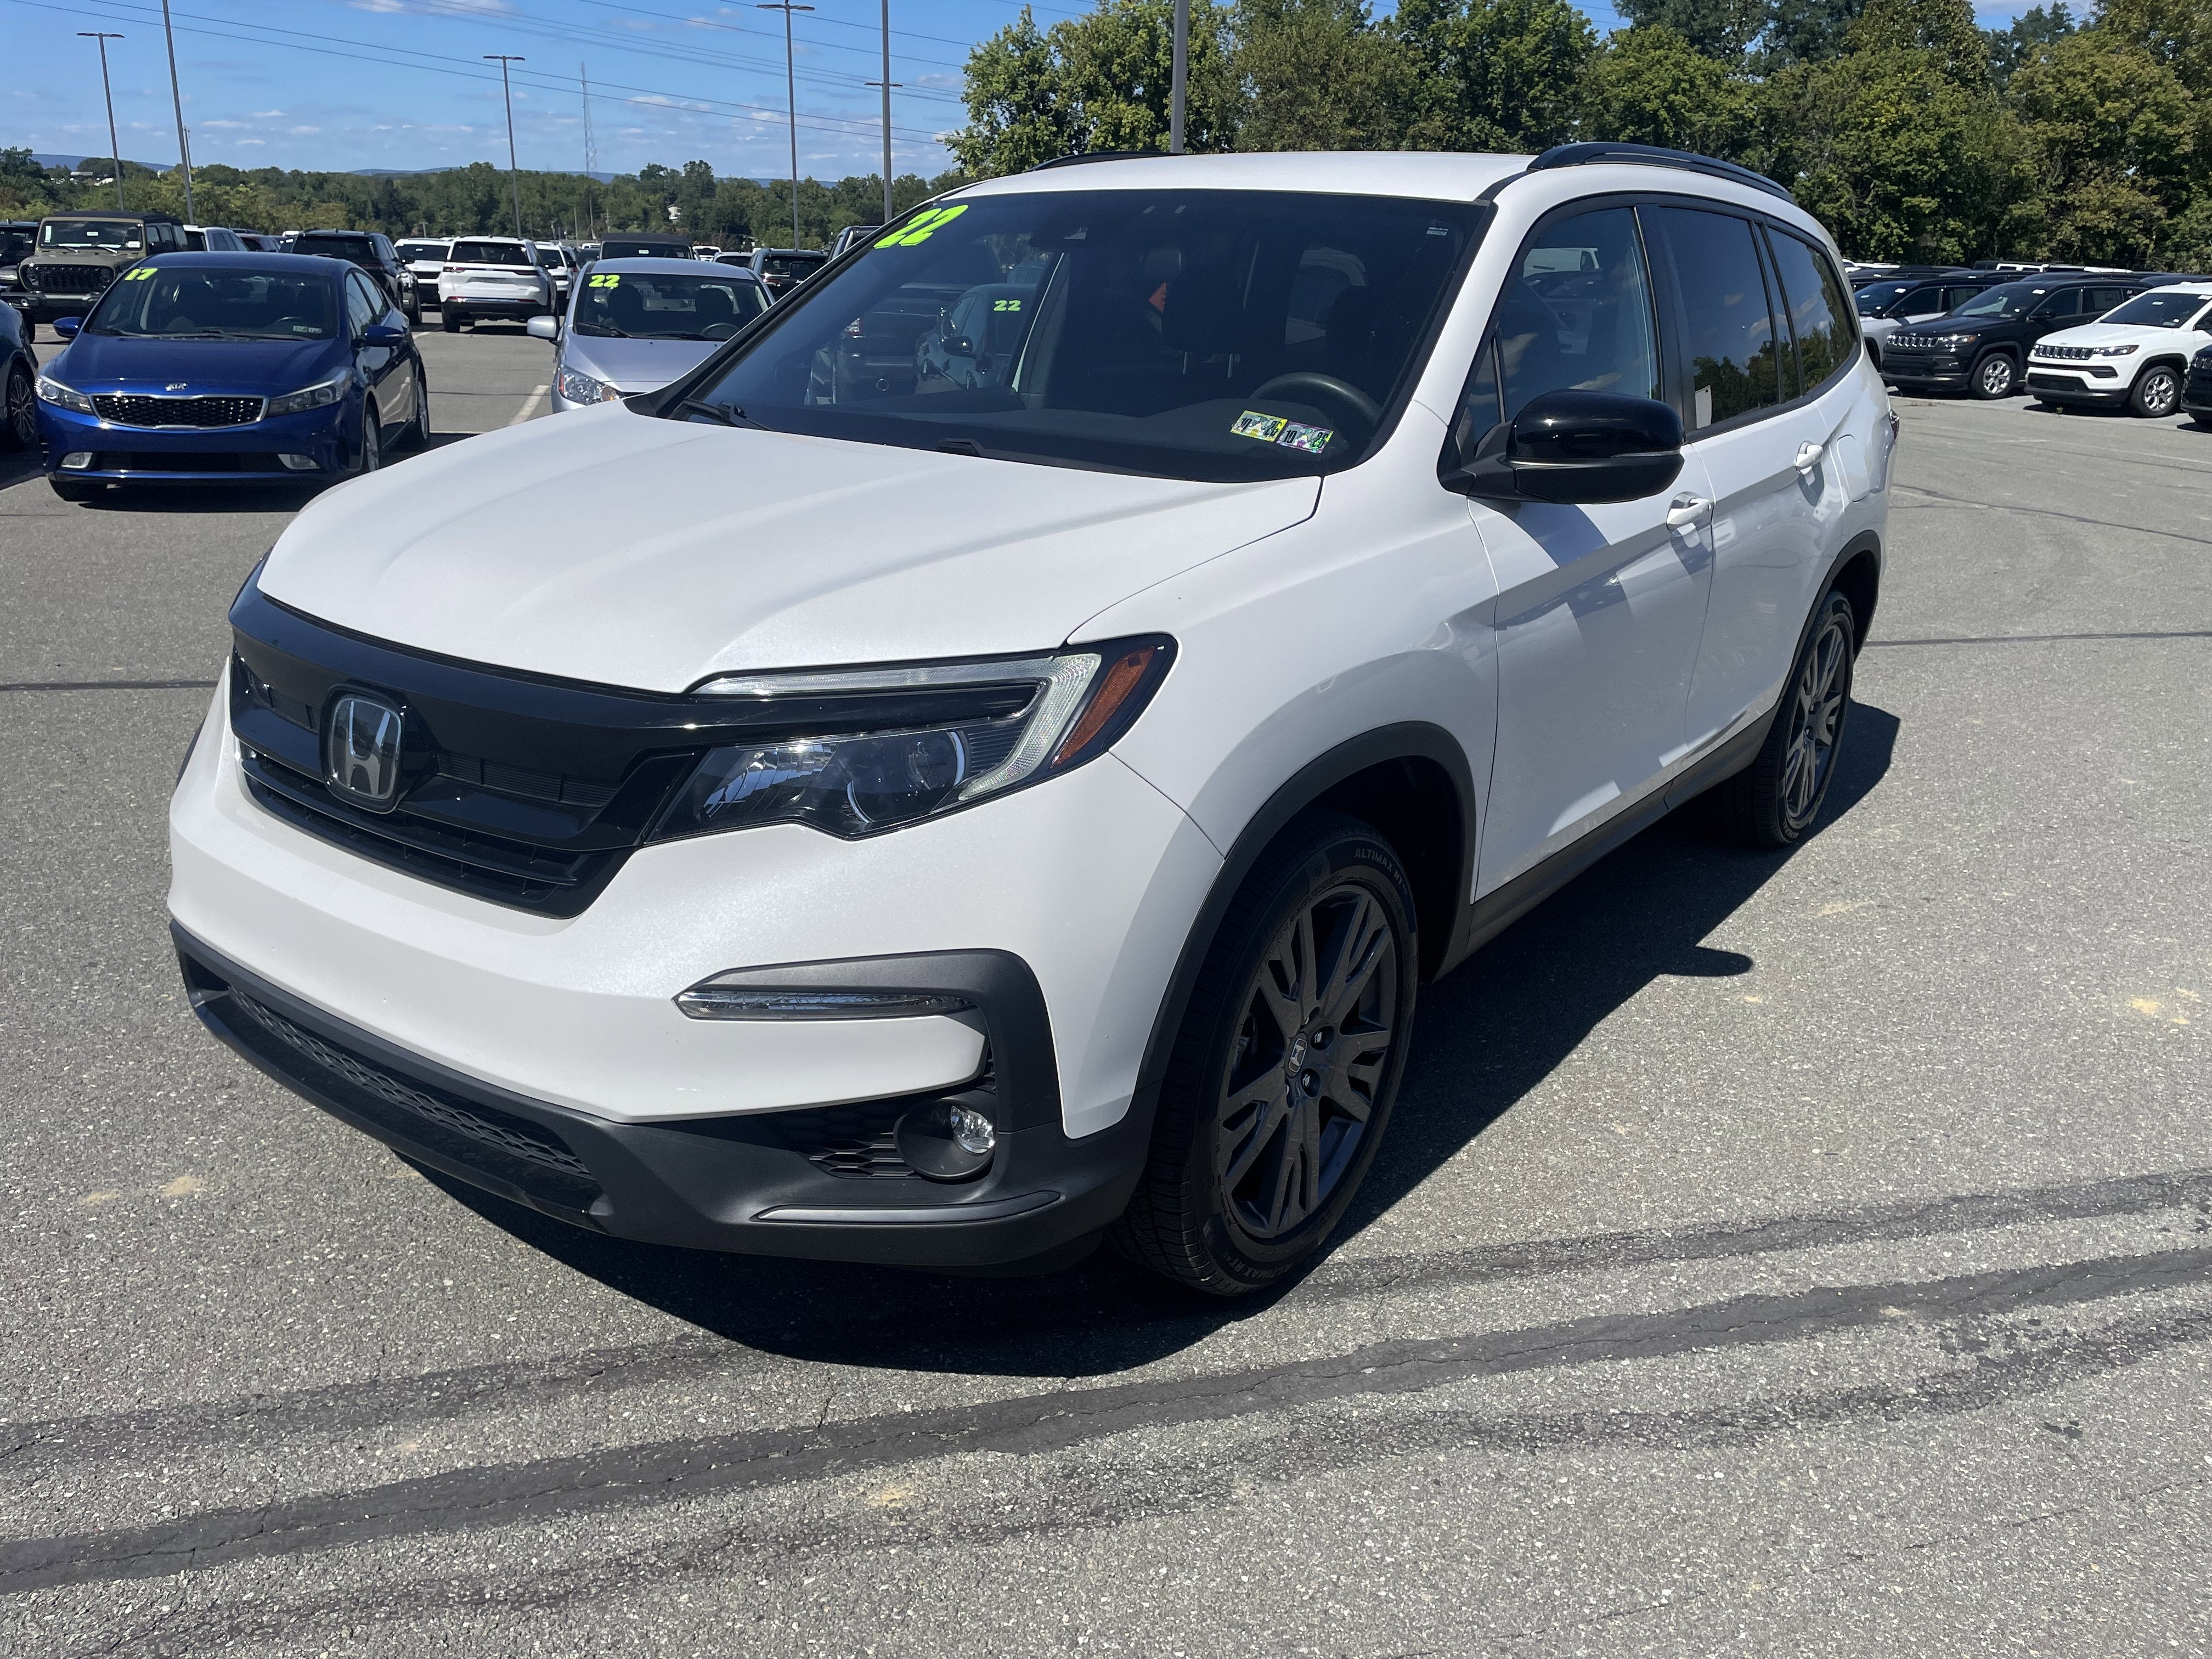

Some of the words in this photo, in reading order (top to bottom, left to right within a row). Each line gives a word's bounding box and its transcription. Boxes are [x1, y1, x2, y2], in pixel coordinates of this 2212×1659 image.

[873, 205, 969, 249] 22
[125, 268, 159, 280] 17
[589, 274, 620, 288] 22
[993, 300, 1021, 312] 22
[1354, 848, 1393, 872] ALTIMAX
